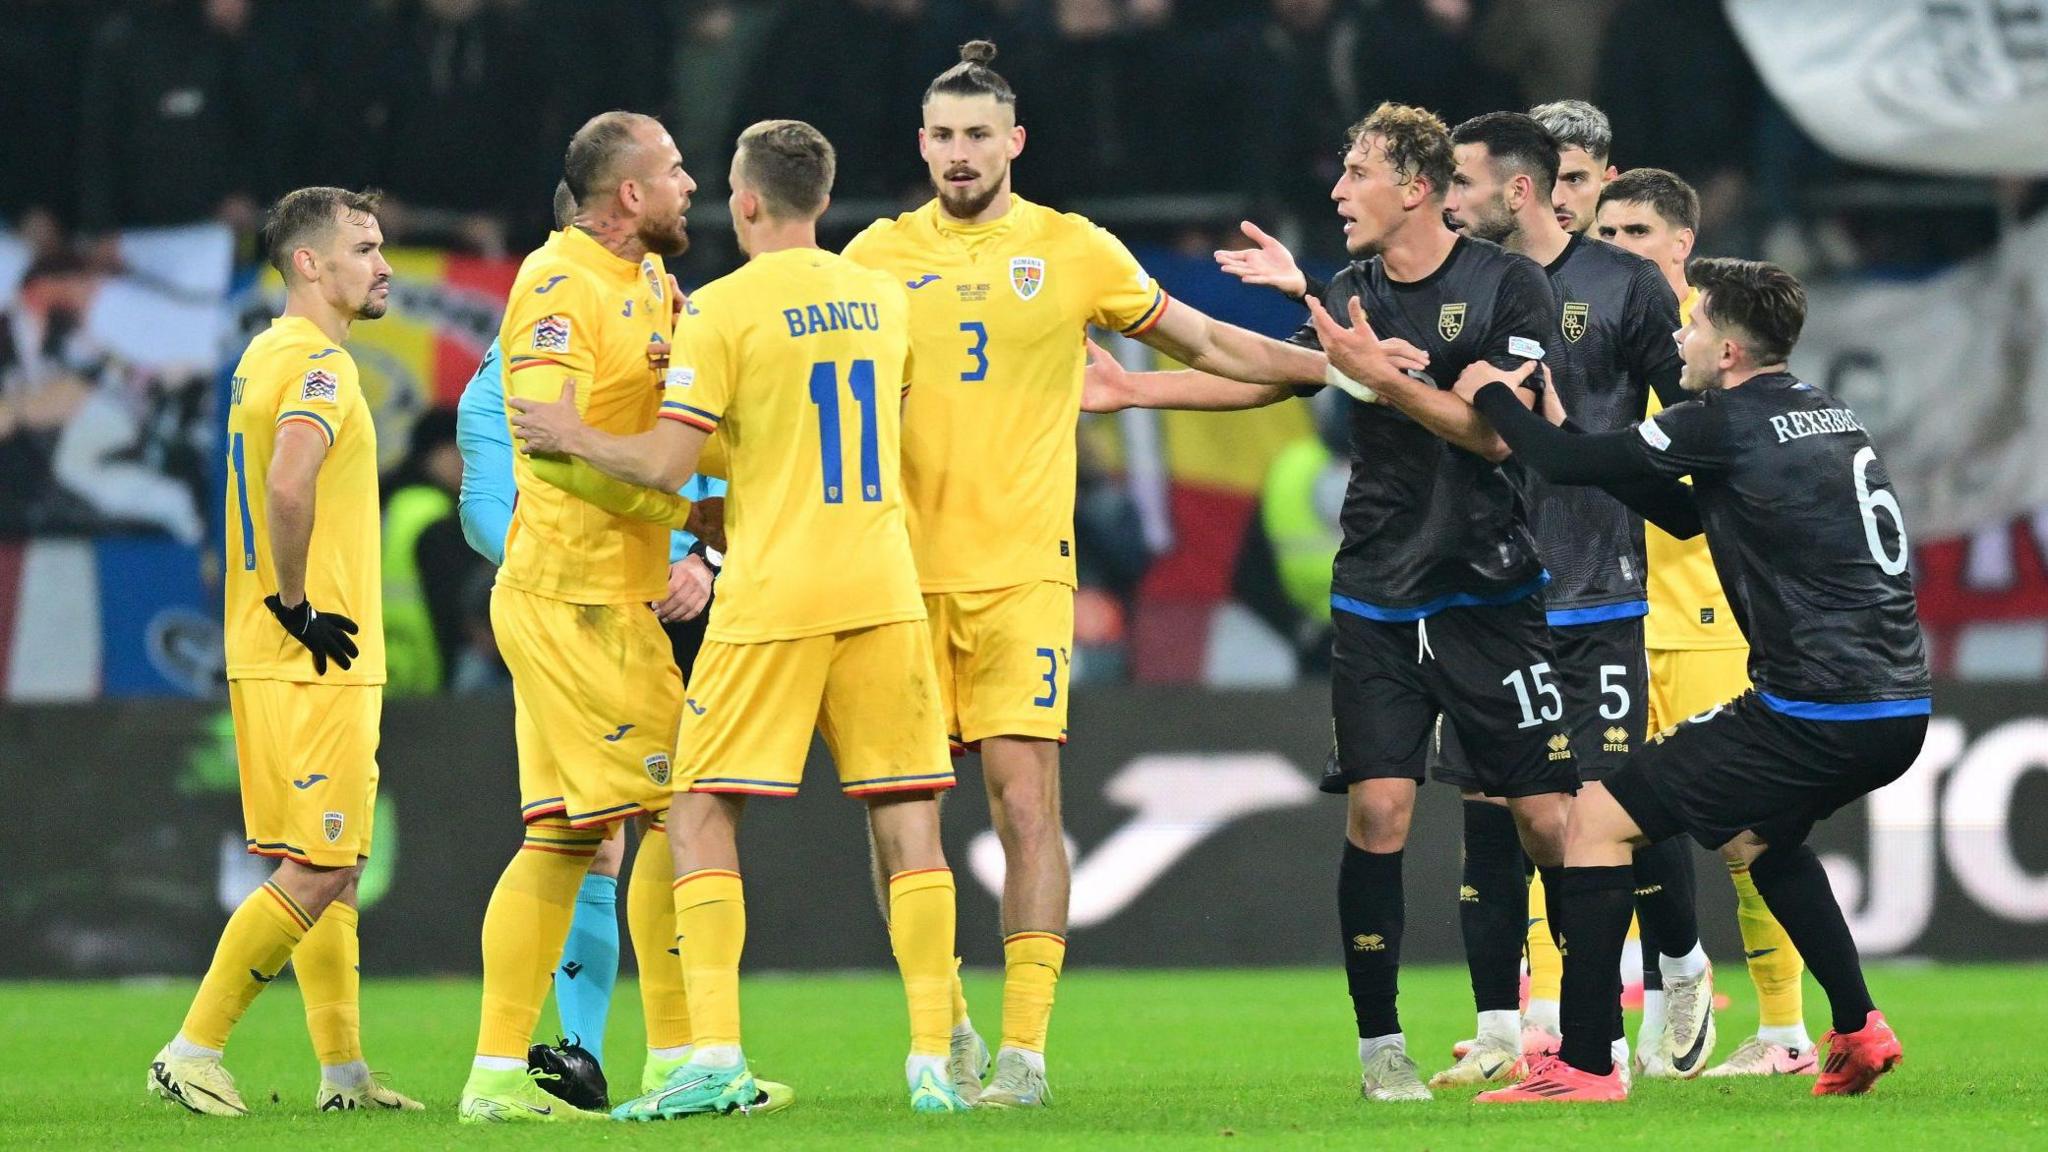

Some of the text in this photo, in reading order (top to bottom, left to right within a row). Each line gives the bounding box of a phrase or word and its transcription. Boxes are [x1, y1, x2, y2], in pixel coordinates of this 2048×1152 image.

[783, 301, 880, 337] BANCU
[959, 321, 989, 381] 3
[809, 360, 883, 504] 11
[1853, 446, 1908, 576] 6
[1034, 647, 1058, 708] 3
[1502, 662, 1563, 729] 15
[1599, 665, 1631, 720] 5
[1602, 743, 1629, 753] errea
